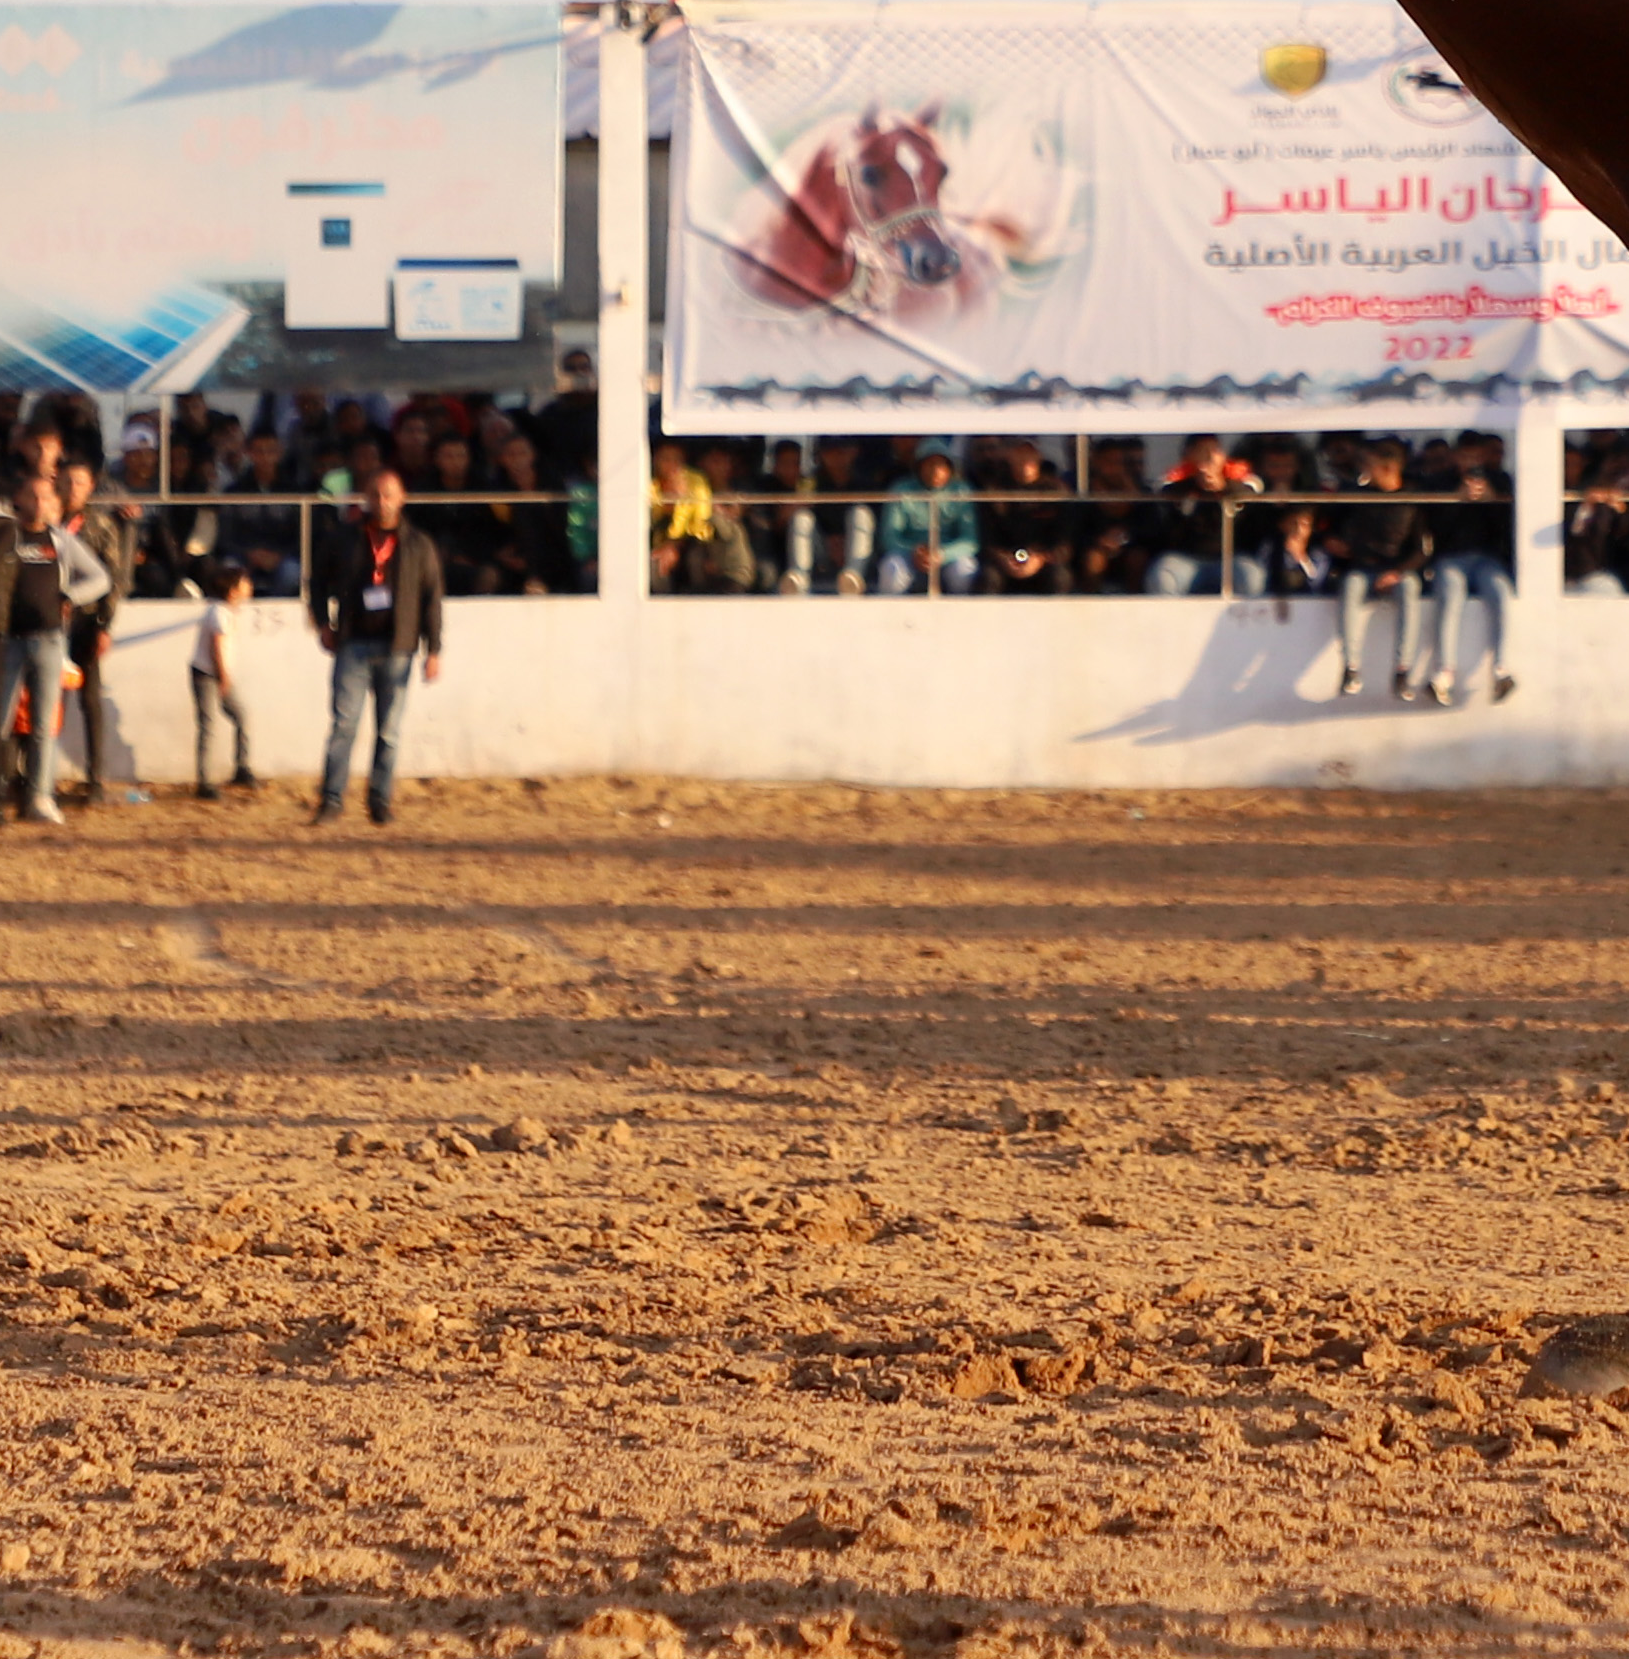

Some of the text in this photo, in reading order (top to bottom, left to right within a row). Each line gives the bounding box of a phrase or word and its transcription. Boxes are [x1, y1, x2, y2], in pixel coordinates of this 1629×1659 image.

[1211, 175, 1583, 226] رجان الياسر
[1341, 238, 1462, 273] العربية
[1473, 238, 1566, 271] الخيل
[1383, 334, 1475, 362] 2022
